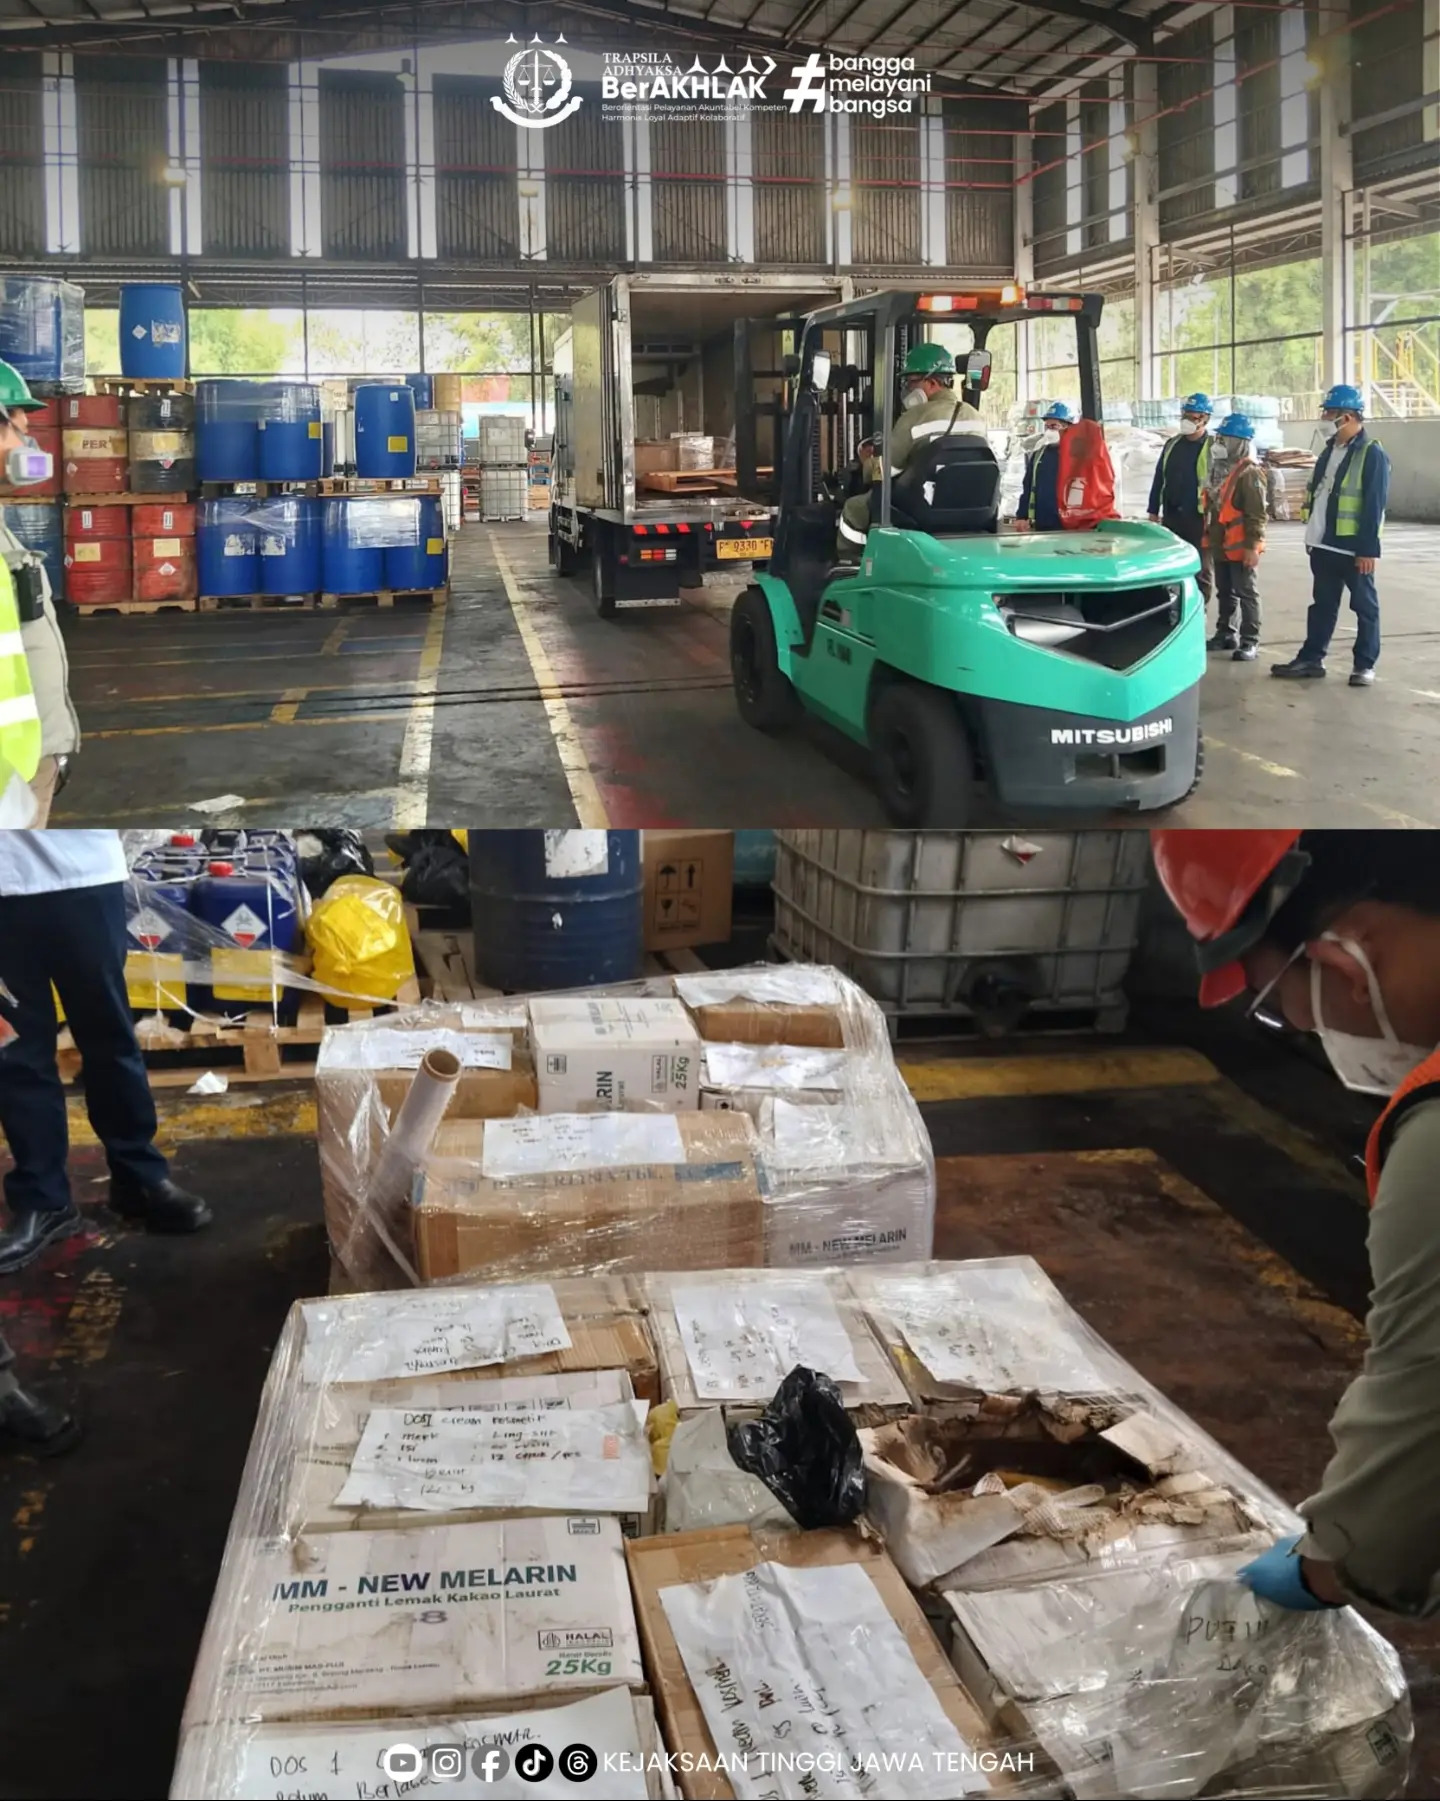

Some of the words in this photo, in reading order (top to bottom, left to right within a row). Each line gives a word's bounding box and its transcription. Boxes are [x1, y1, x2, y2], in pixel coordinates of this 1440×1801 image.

[1051, 718, 1172, 744] MITSUBISHI
[676, 1056, 690, 1090] 25Kg
[273, 1579, 329, 1601] MM
[357, 1573, 431, 1595] NEW
[440, 1565, 577, 1590] MELARIN
[288, 1598, 380, 1613] Pengganti
[384, 1594, 442, 1607] Lemak
[447, 1592, 502, 1604] Kakao
[505, 1588, 561, 1600] Laurat
[565, 1631, 611, 1641] HALAL
[545, 1659, 612, 1677] 25Kg
[270, 1756, 308, 1777] DOS
